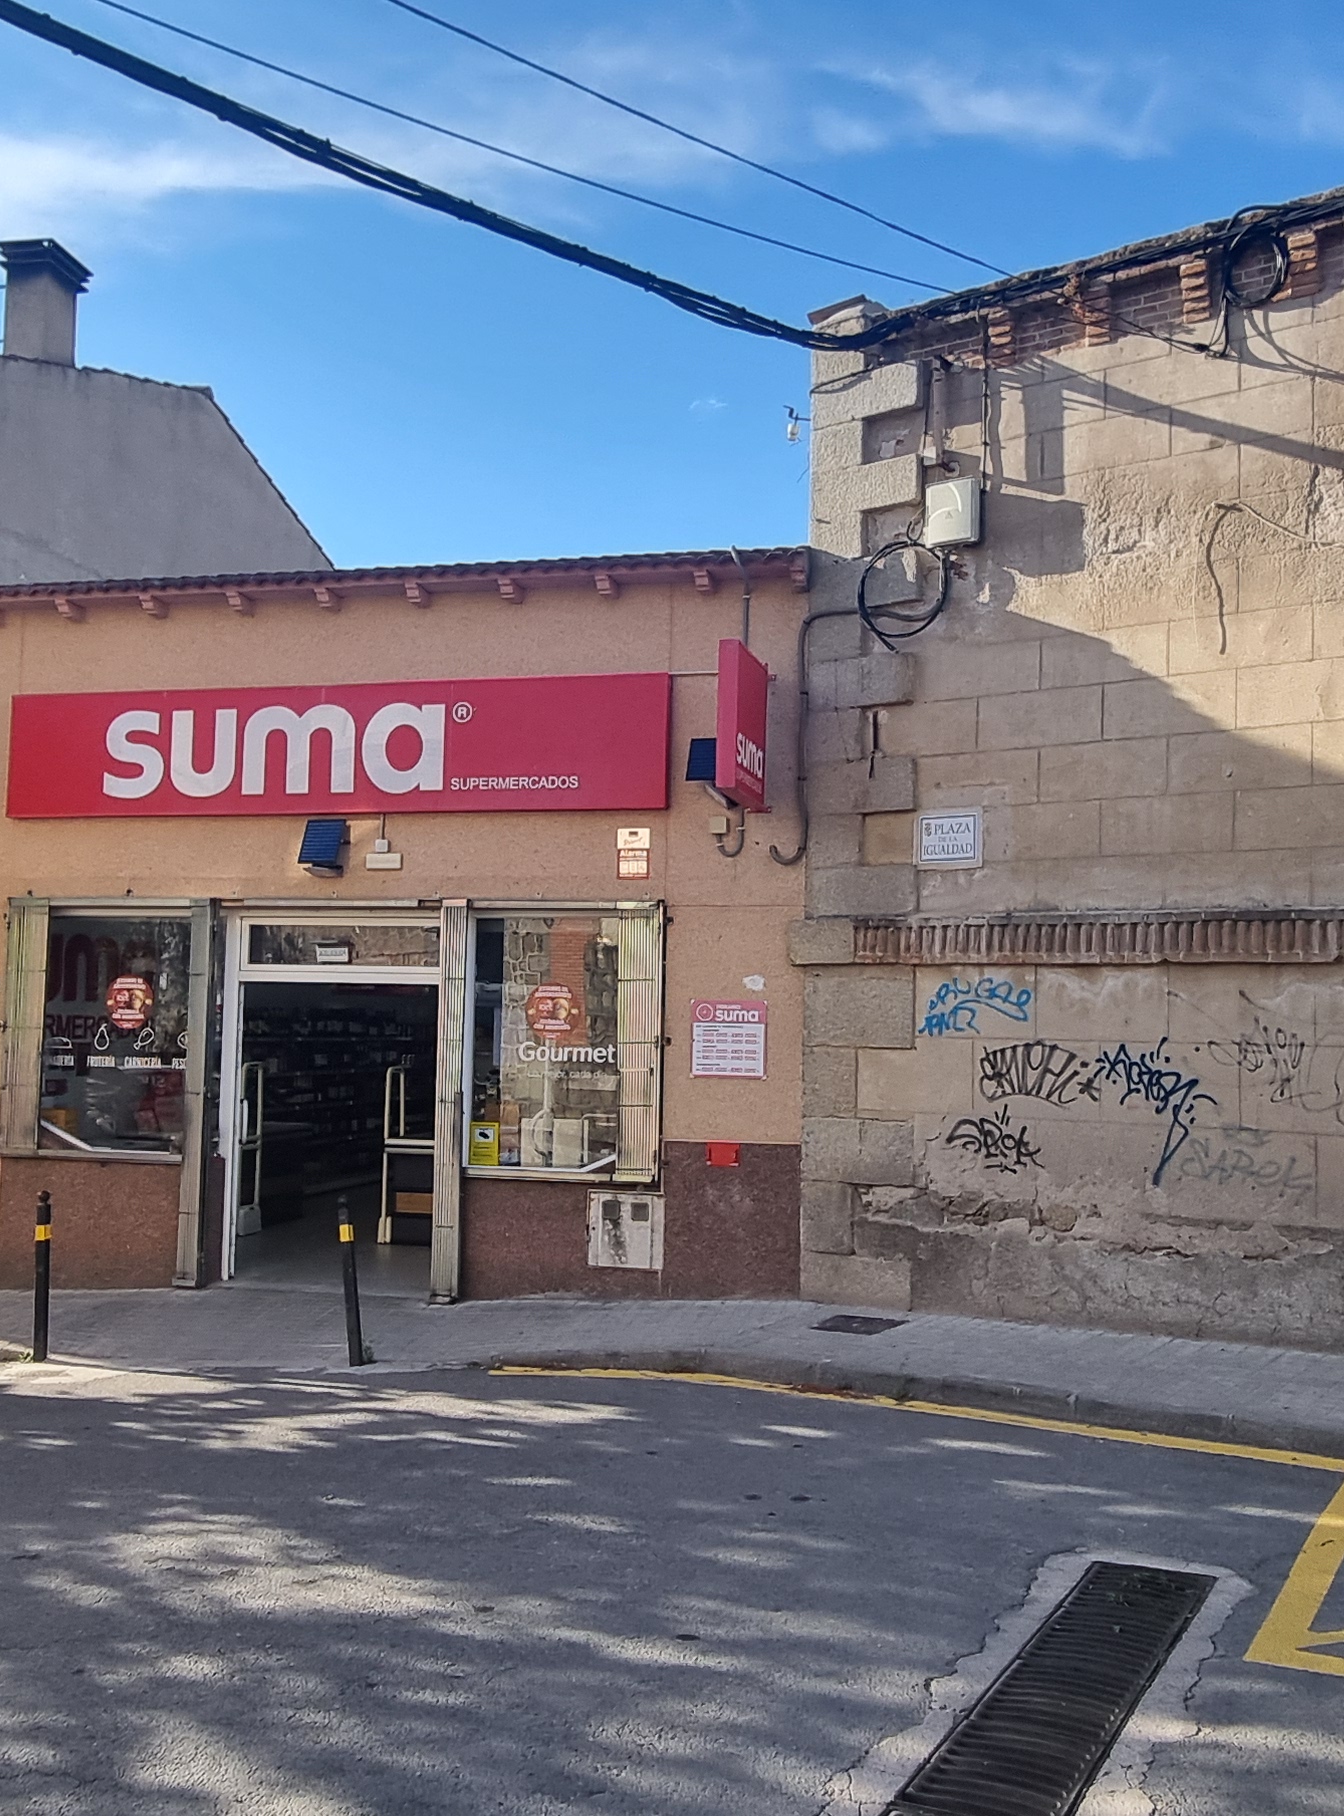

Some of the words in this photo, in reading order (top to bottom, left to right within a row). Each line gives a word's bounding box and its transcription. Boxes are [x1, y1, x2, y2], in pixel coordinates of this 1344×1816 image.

[103, 702, 446, 799] suma
[736, 732, 763, 779] suma
[451, 776, 579, 790] SUPERMERCADOS
[934, 822, 972, 836] PLAZA
[924, 843, 973, 856] IGUALDAD
[715, 1010, 759, 1022] suma
[518, 1041, 617, 1064] Gourmet
